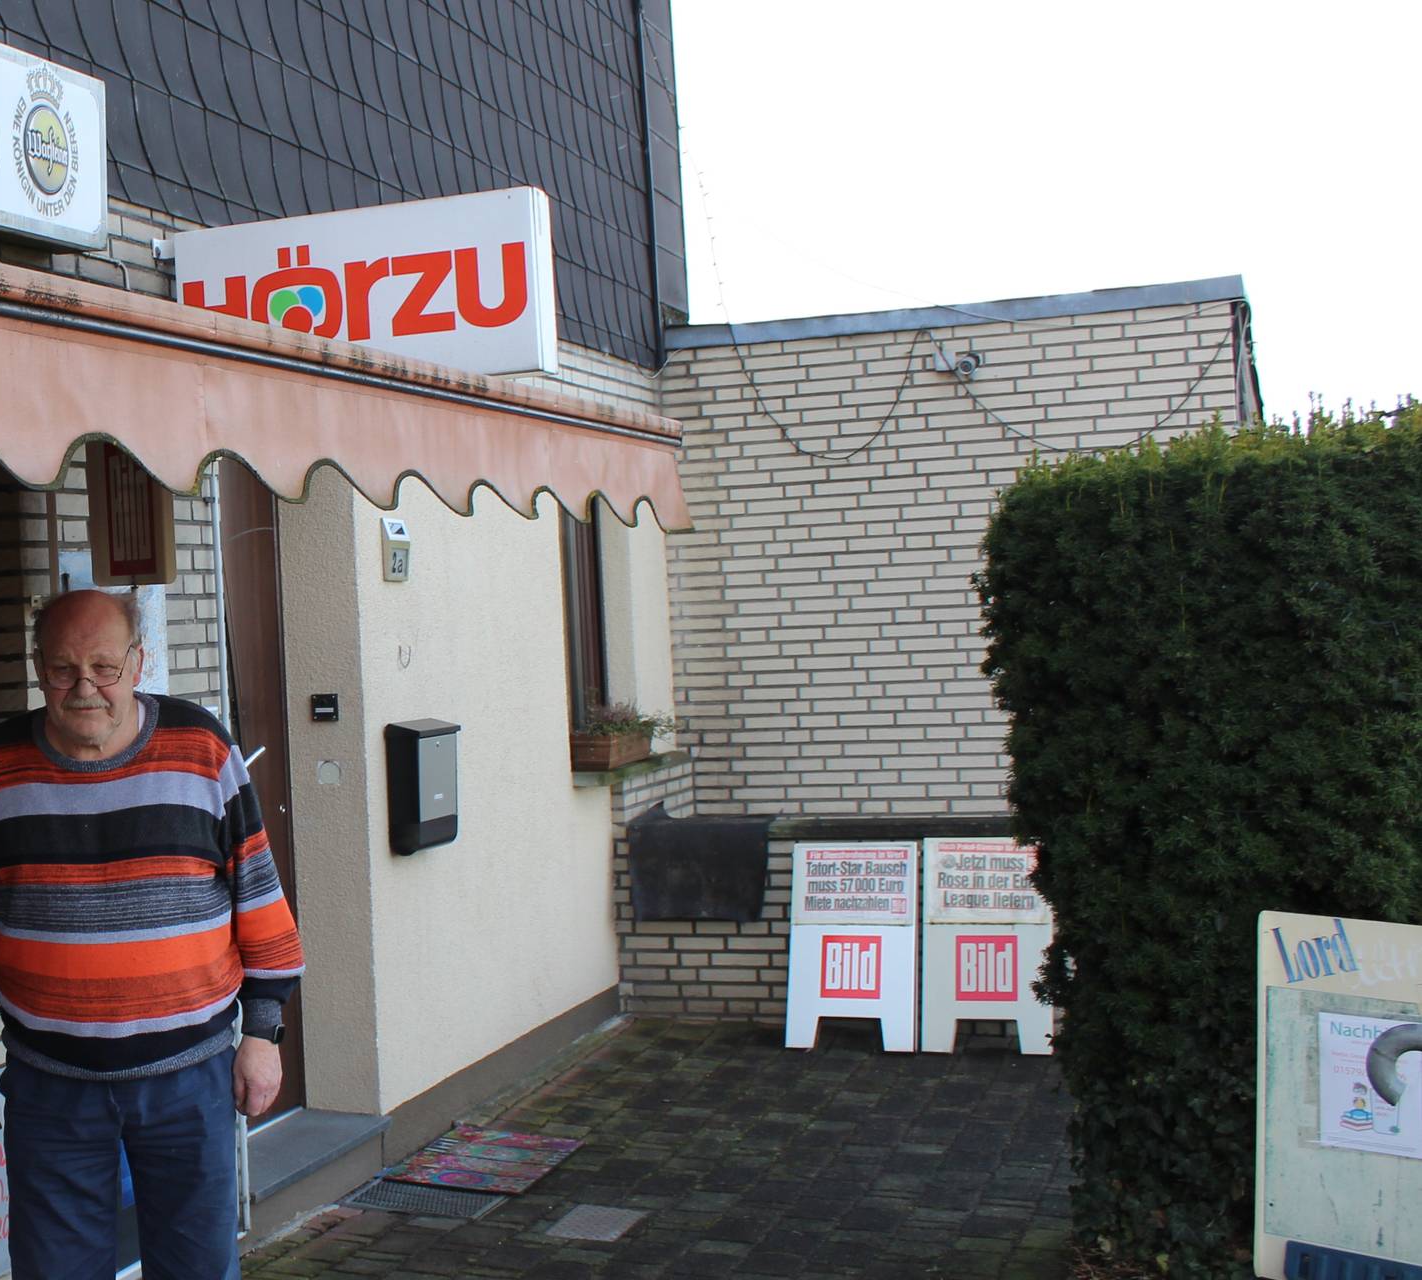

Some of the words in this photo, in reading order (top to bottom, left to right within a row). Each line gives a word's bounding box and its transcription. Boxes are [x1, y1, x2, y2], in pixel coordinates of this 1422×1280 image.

[12, 96, 27, 131] EINE
[63, 110, 79, 170] BIEREN
[12, 134, 35, 204] KÖNIGIN
[63, 177, 78, 206] DEN
[36, 199, 66, 217] UNTER
[392, 551, 404, 574] 2a
[806, 861, 862, 876] Tatort-Star
[865, 861, 907, 876] Bausch
[955, 855, 987, 870] Jetzt
[990, 857, 1024, 870] muss
[808, 881, 838, 892] muss
[878, 878, 904, 893] Euro
[938, 872, 969, 888] Rose
[973, 872, 985, 887] in
[988, 873, 1009, 888] der
[804, 896, 832, 911] Miete
[943, 891, 990, 908] League
[993, 892, 1034, 909] liefern
[1272, 918, 1360, 984] Lord
[825, 942, 878, 991] Bild
[960, 942, 1013, 993] Bild
